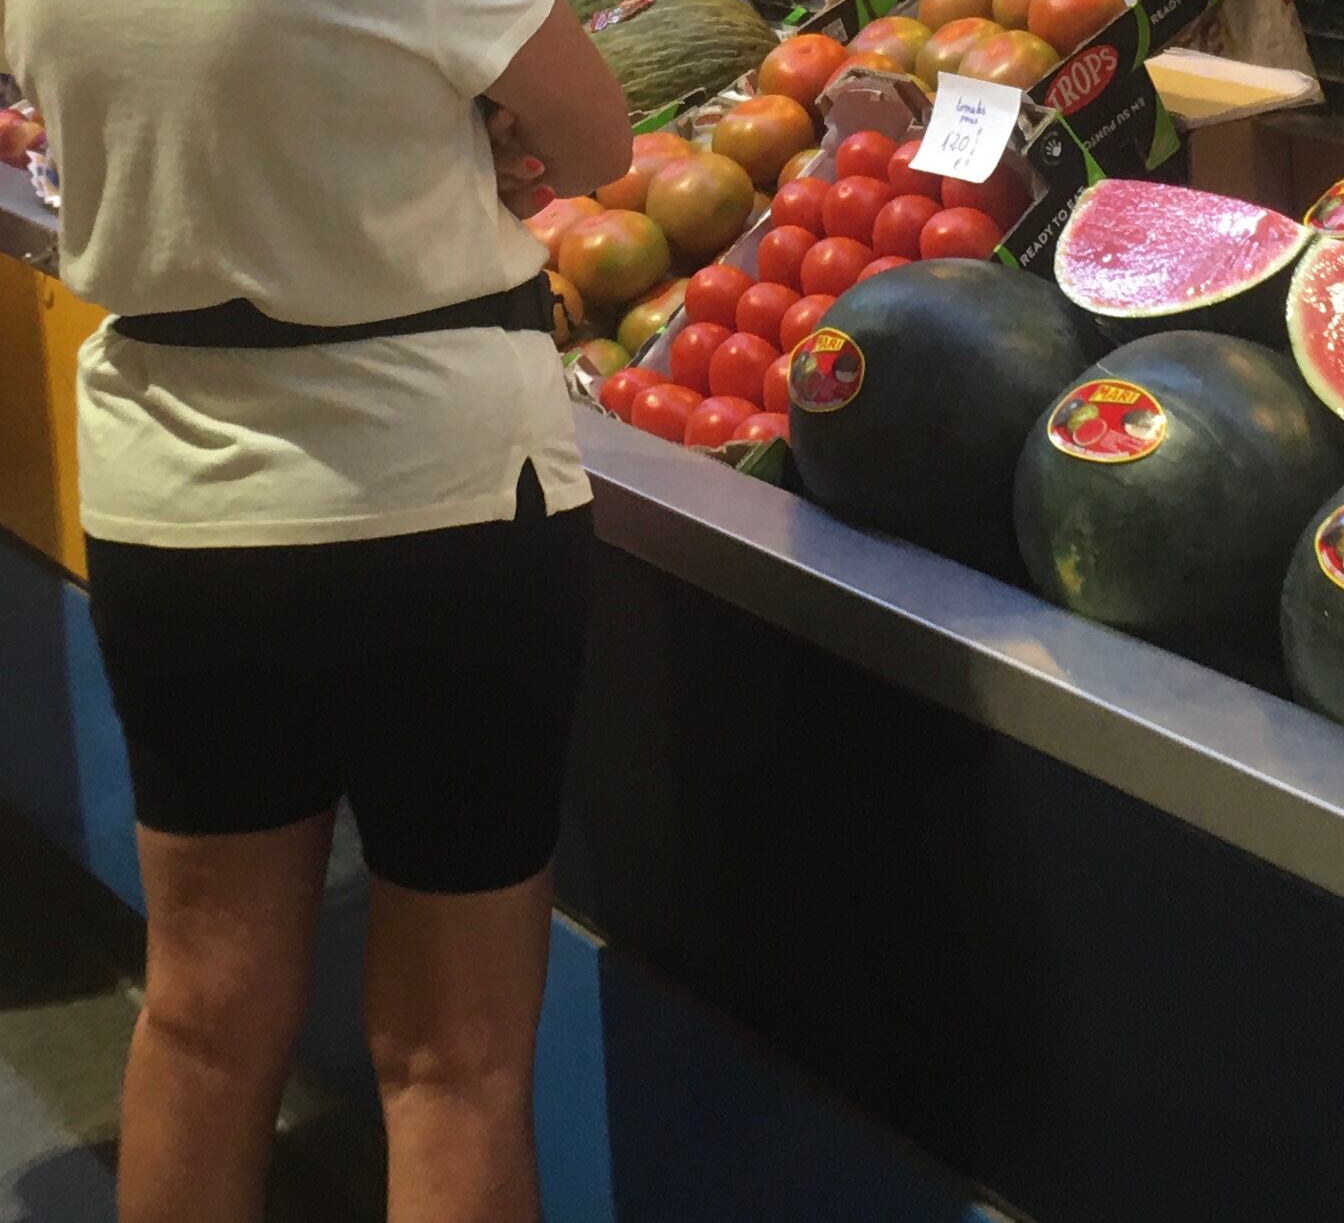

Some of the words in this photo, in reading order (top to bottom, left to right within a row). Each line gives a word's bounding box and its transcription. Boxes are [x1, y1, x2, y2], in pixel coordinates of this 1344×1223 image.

[1045, 45, 1120, 115] TROPS
[1018, 222, 1054, 267] READY
[1051, 208, 1068, 228] TO
